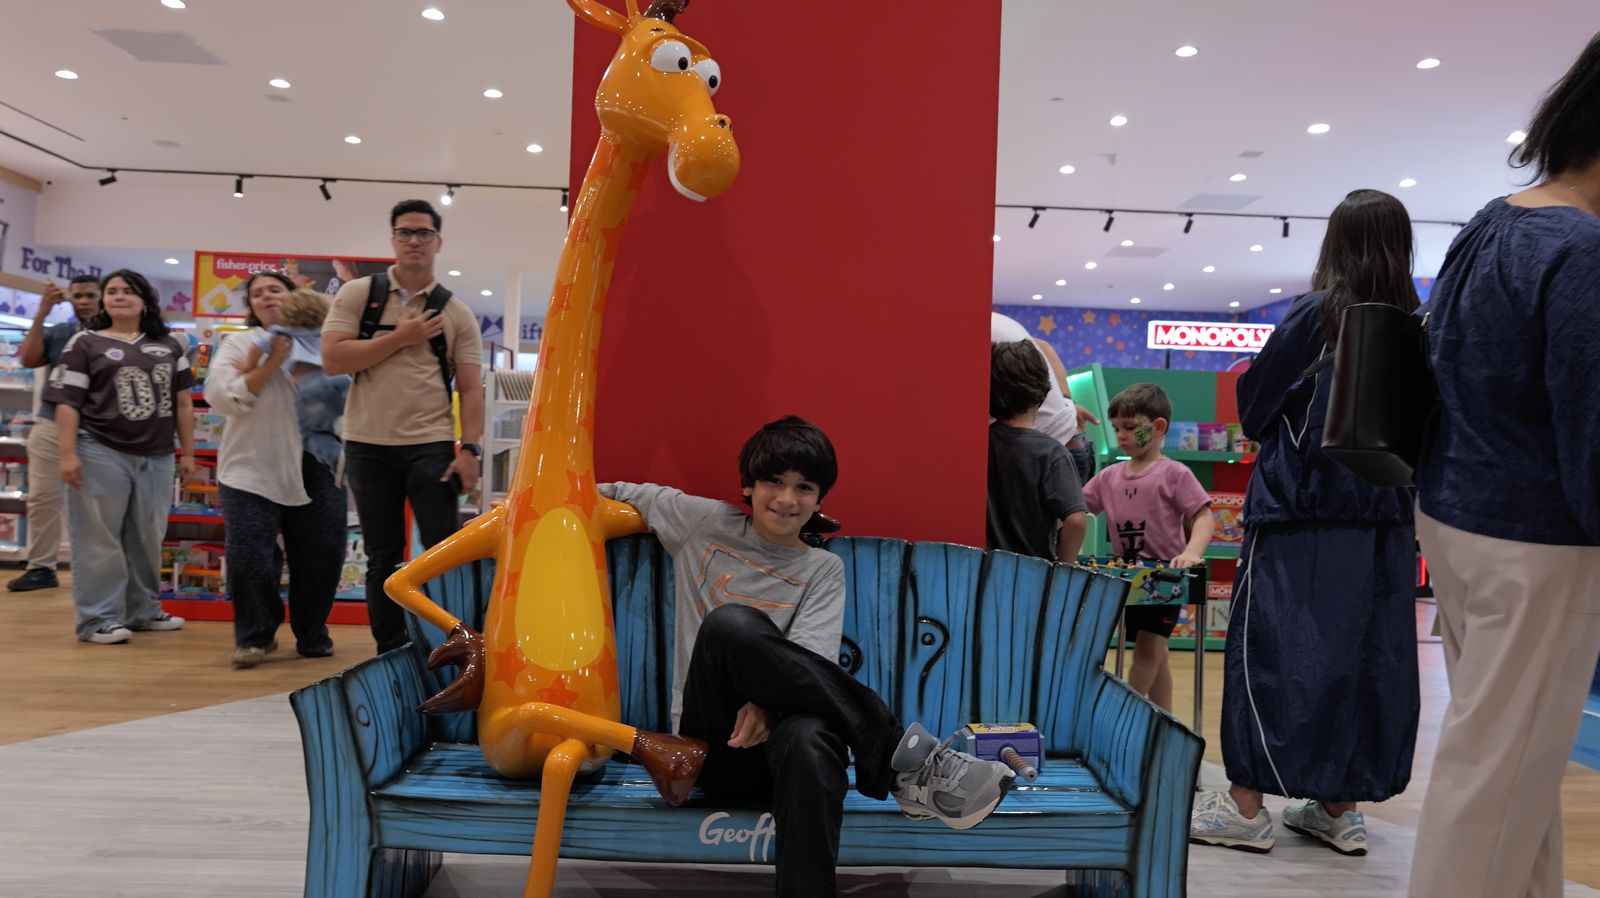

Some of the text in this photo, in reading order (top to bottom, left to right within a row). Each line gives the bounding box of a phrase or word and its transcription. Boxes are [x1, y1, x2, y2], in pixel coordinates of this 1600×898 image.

[21, 246, 51, 275] For
[1155, 325, 1274, 348] MONOPOLY
[115, 363, 174, 420] 01
[909, 784, 928, 805] N
